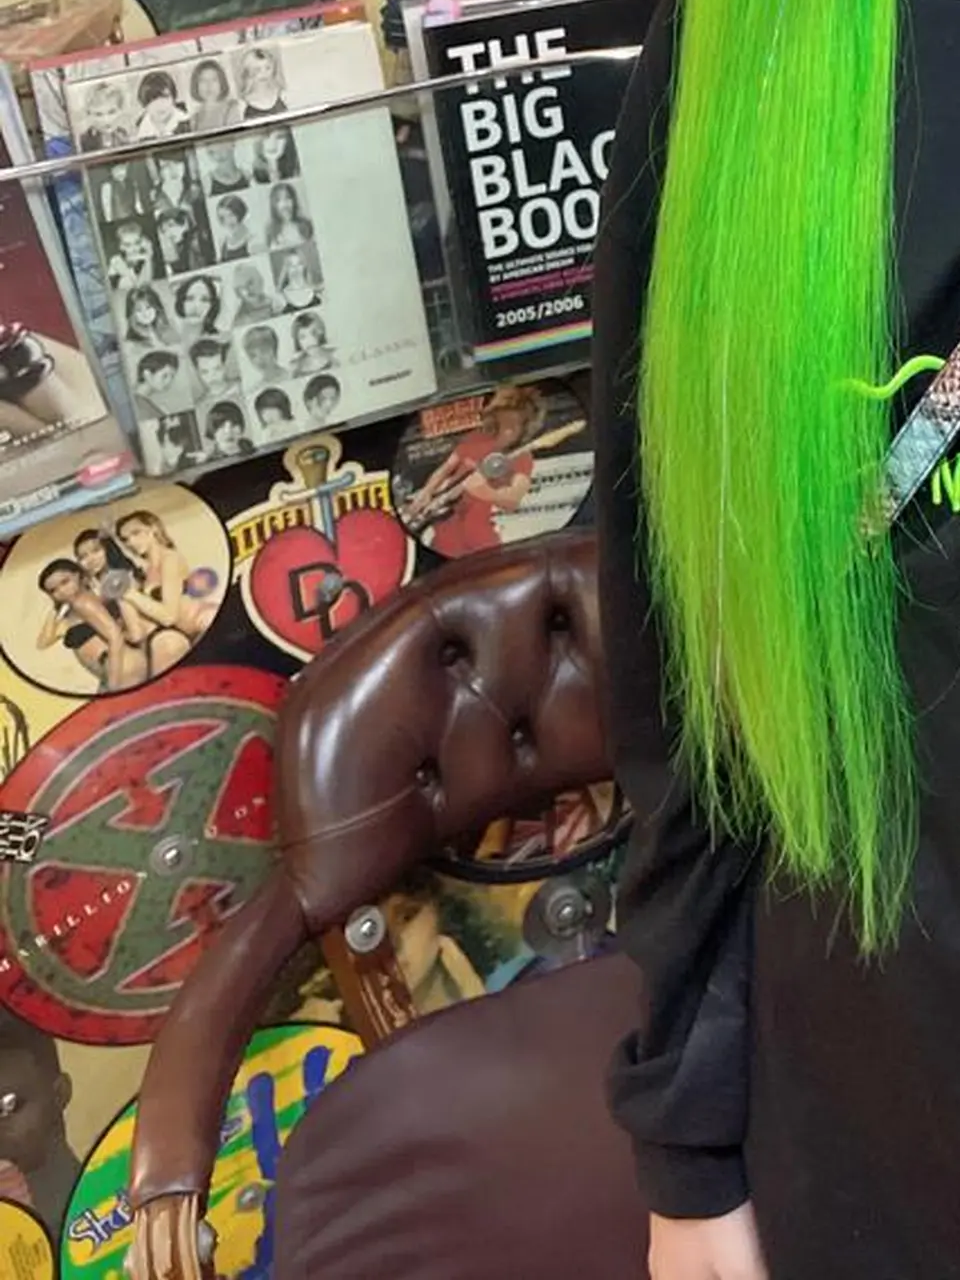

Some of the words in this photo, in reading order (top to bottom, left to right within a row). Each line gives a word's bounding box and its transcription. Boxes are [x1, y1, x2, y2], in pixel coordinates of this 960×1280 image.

[447, 28, 572, 95] THE
[460, 86, 564, 153] BIG
[496, 294, 584, 328] 2005/2006
